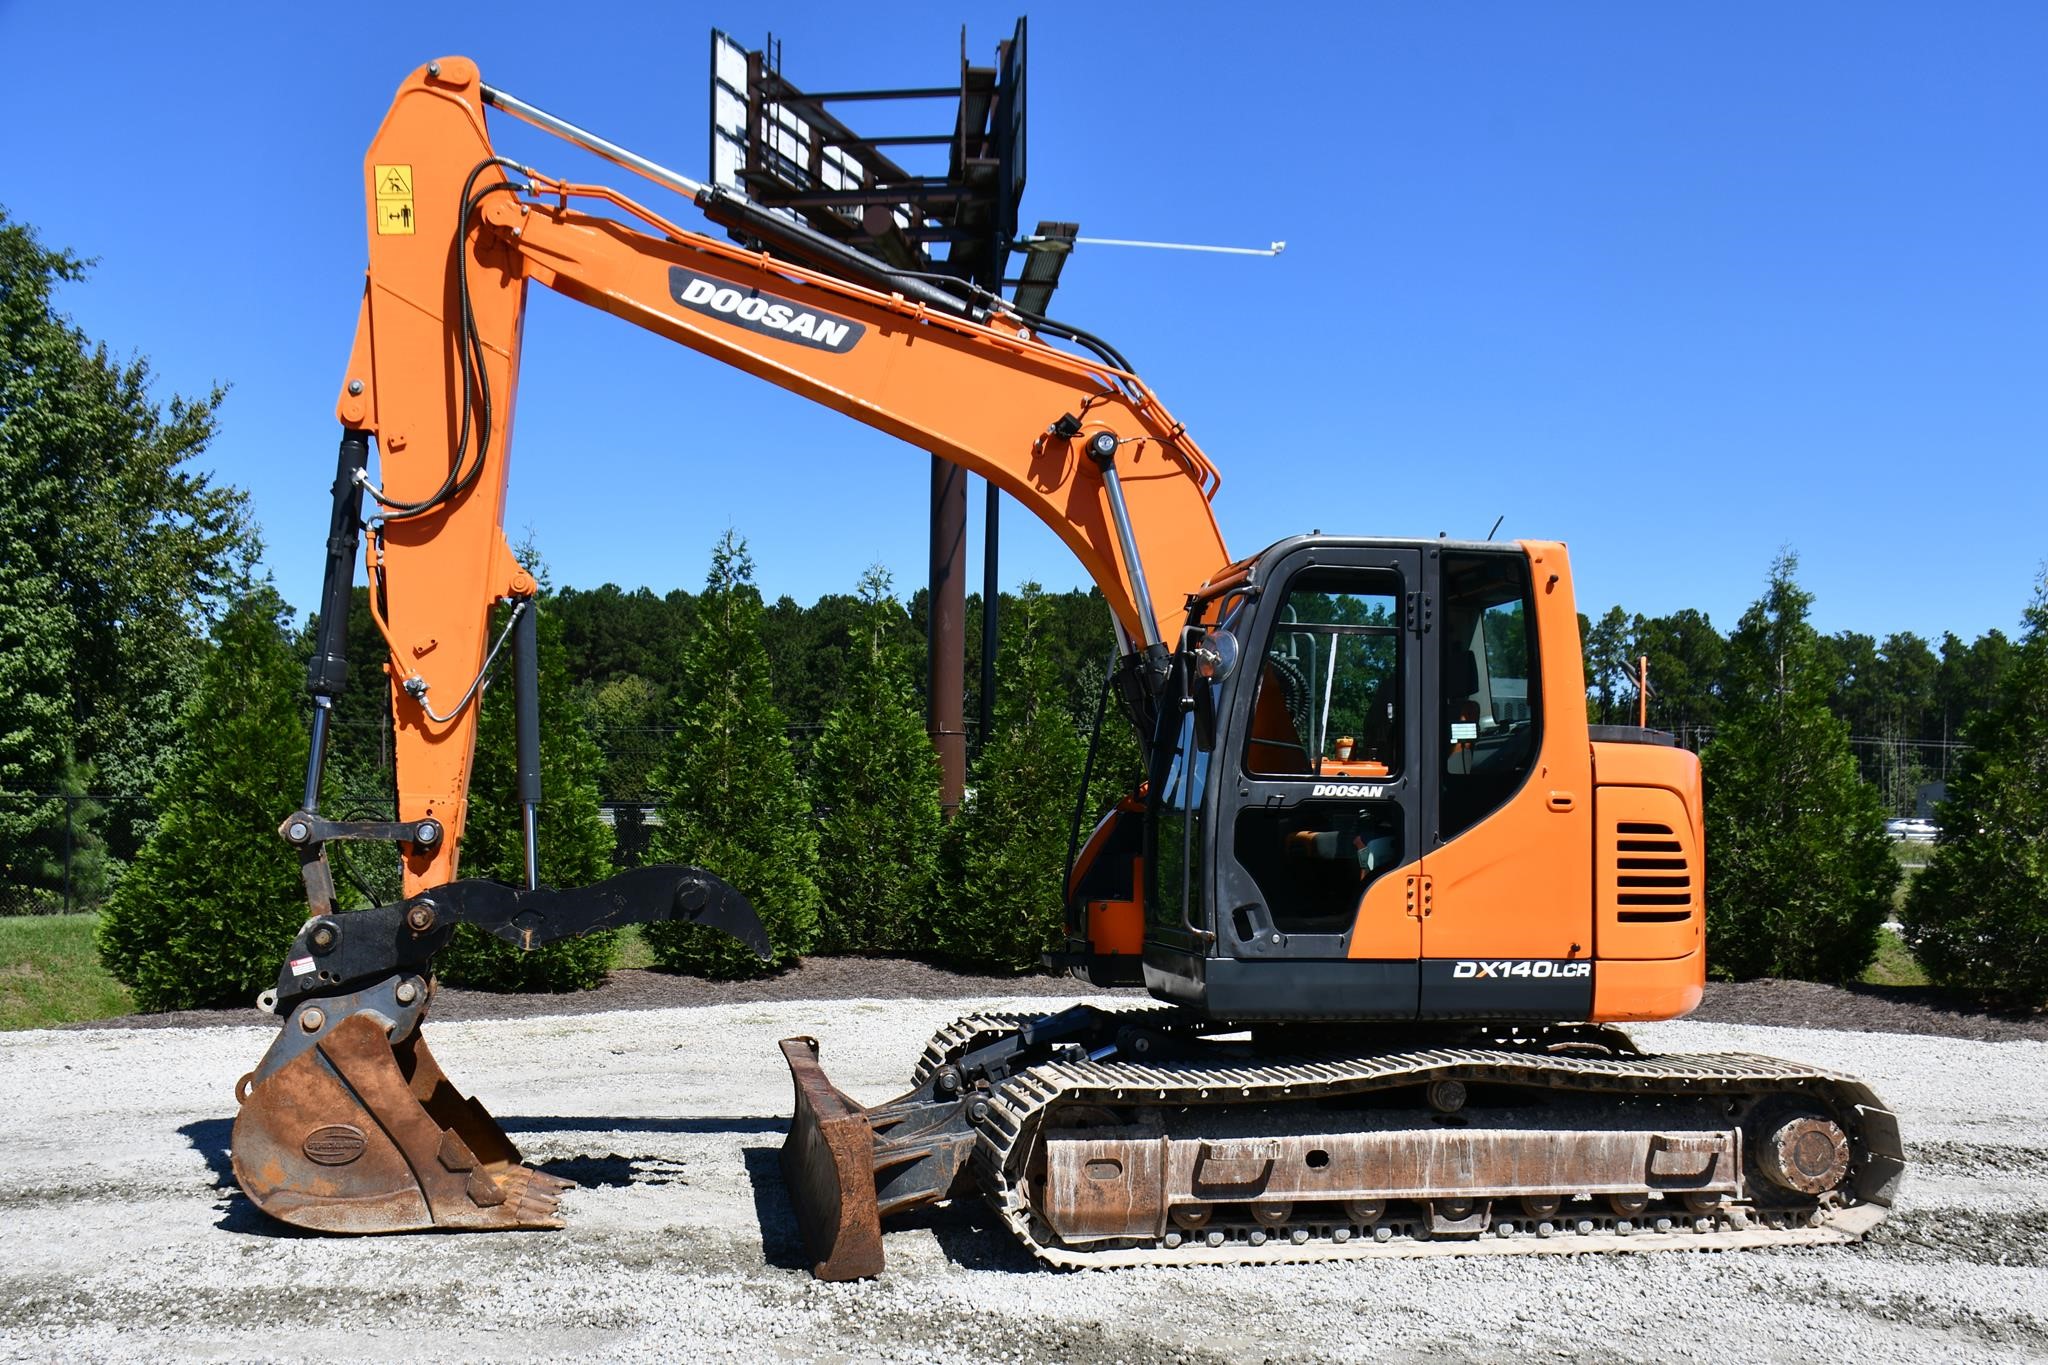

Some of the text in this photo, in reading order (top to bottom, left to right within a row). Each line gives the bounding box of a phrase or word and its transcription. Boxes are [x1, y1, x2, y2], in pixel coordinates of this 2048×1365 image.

[681, 278, 850, 347] DOOSAN
[1312, 784, 1384, 798] DOOSAN
[1453, 961, 1591, 978] DX140LCR
